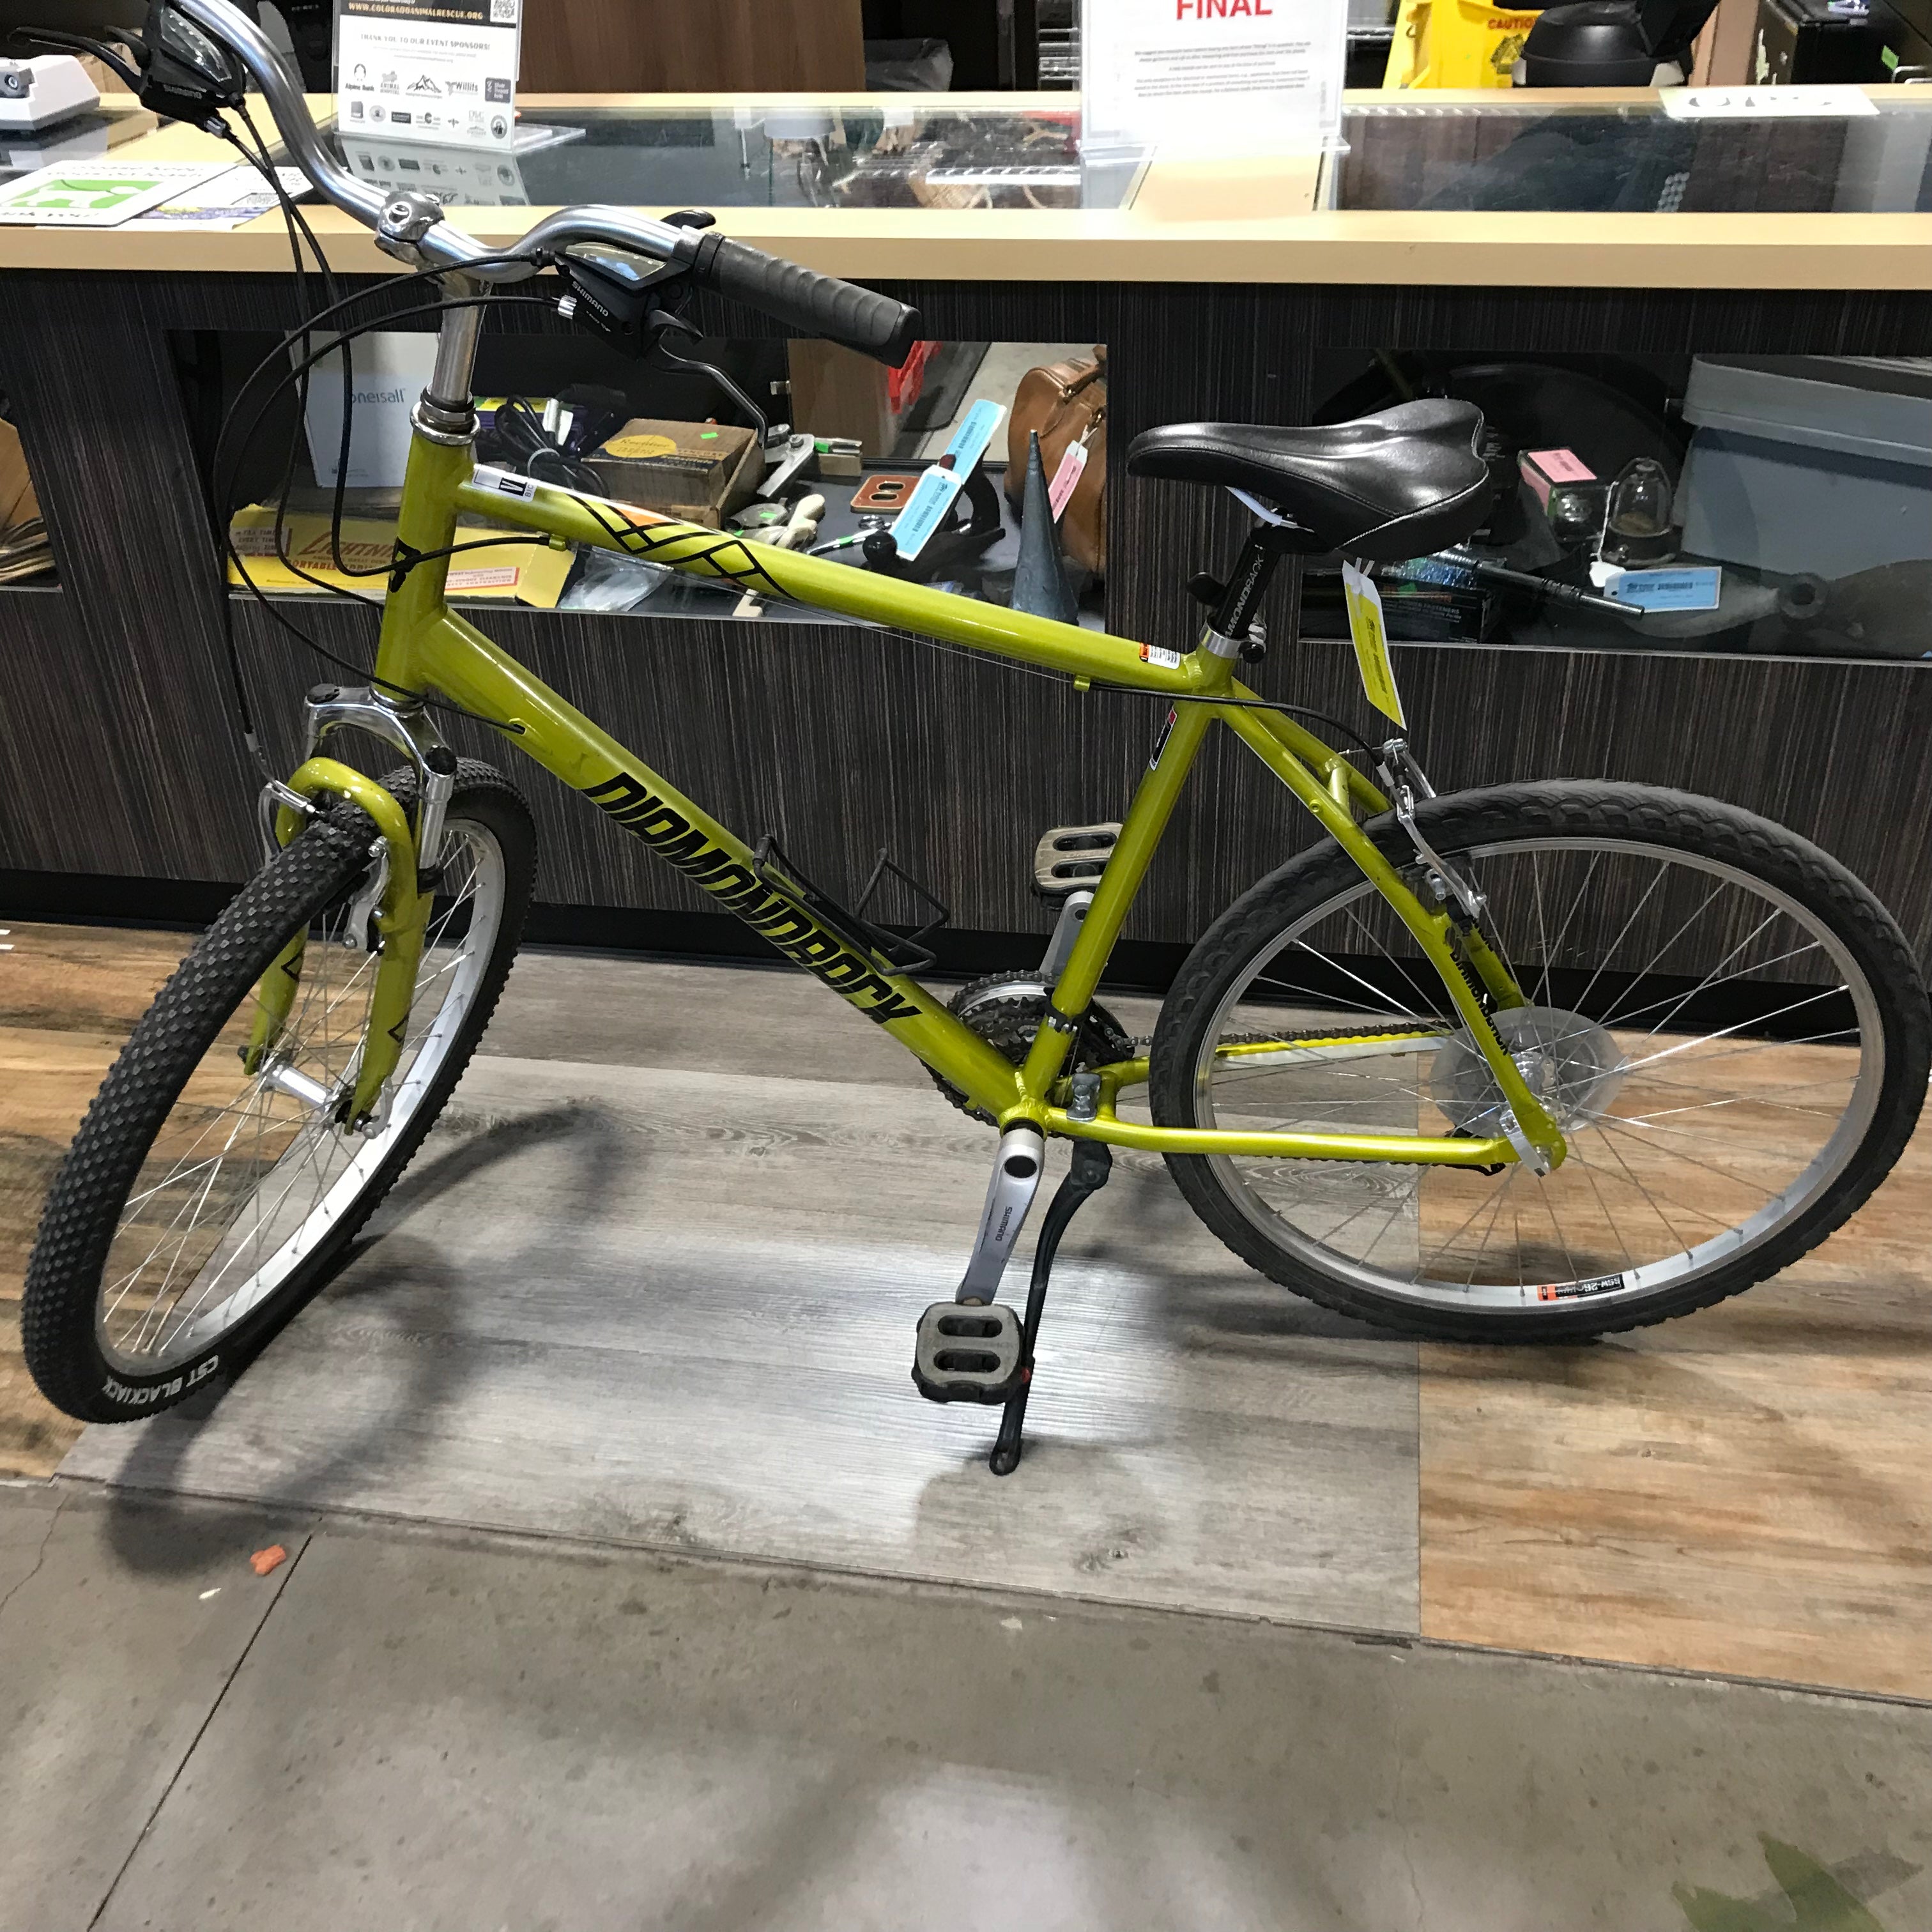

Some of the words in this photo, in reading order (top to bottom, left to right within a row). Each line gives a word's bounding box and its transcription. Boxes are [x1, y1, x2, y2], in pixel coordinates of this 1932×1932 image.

[1176, 0, 1273, 20] FINAL
[1489, 17, 1536, 30] CAUTIO
[361, 33, 382, 42] THANK
[400, 36, 408, 45] TO
[426, 38, 449, 47] EVENT
[450, 40, 491, 50] SPONSORS!
[572, 280, 609, 317] SHIMANO
[289, 559, 337, 571] ORTABLE
[995, 1206, 1013, 1241] SHIMANO
[185, 1354, 219, 1388] CST
[101, 1375, 183, 1405] BLACKJACK
